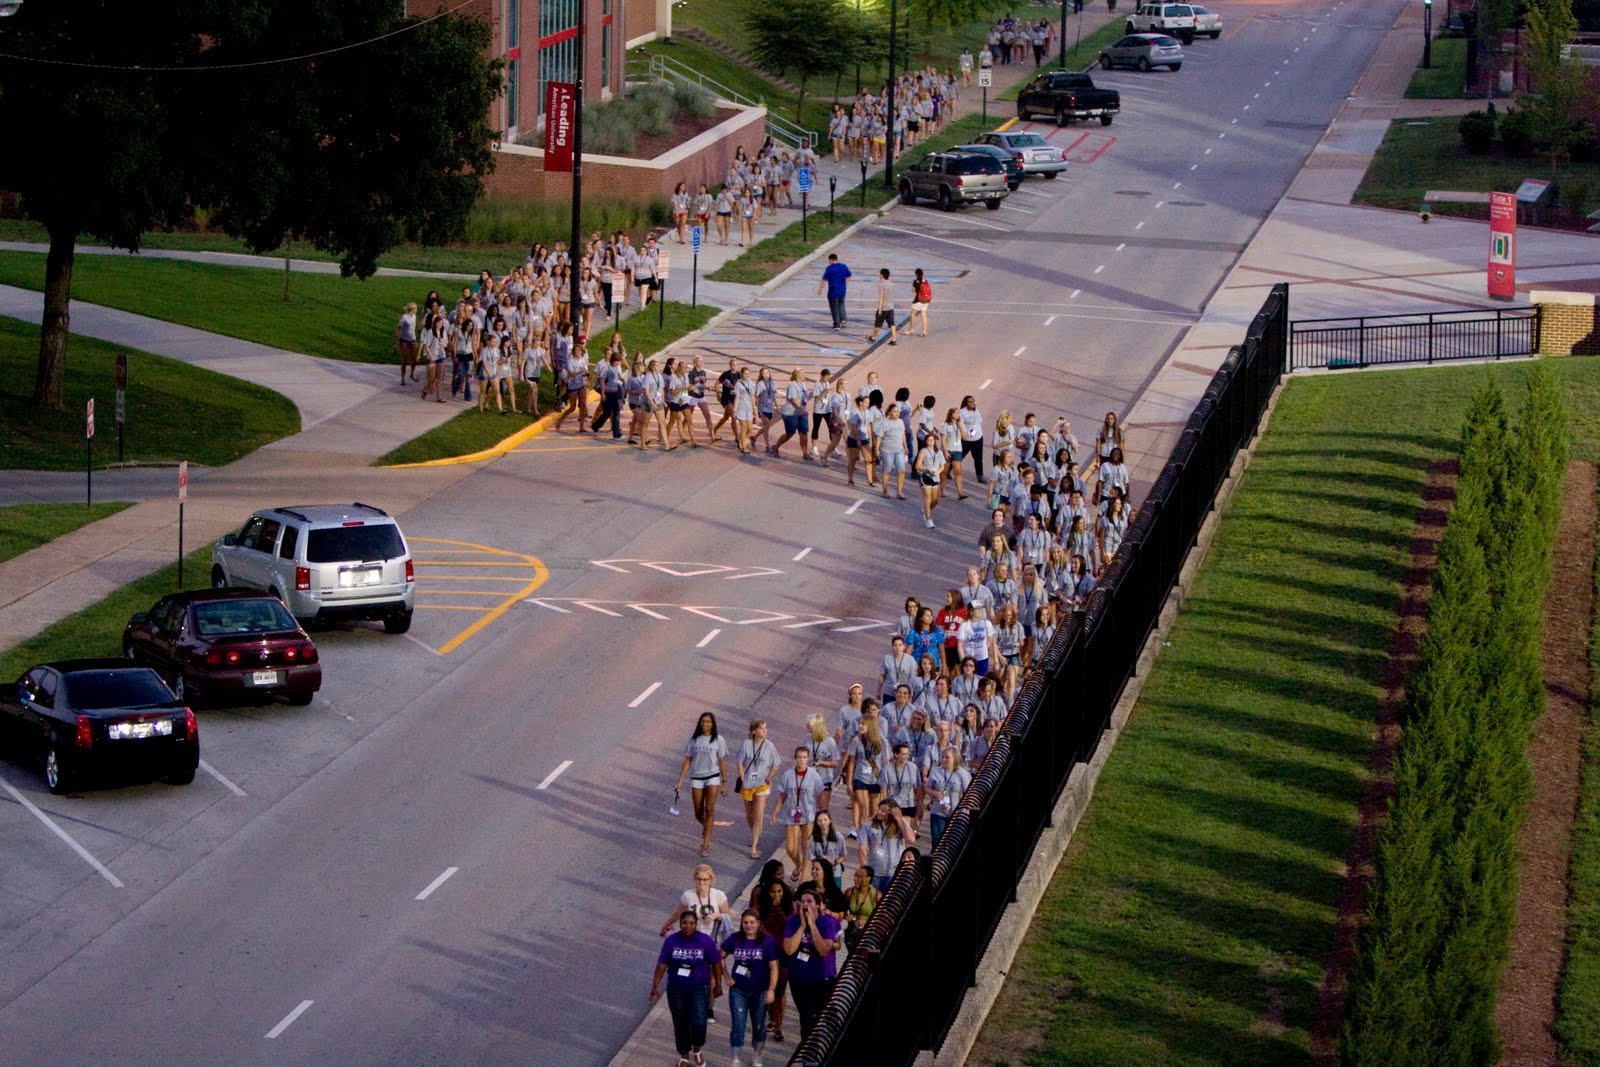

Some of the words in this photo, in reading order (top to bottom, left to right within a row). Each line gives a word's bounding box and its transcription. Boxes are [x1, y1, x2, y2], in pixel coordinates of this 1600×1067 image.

[550, 86, 559, 119] American
[548, 120, 557, 154] University
[556, 95, 571, 147] Leading
